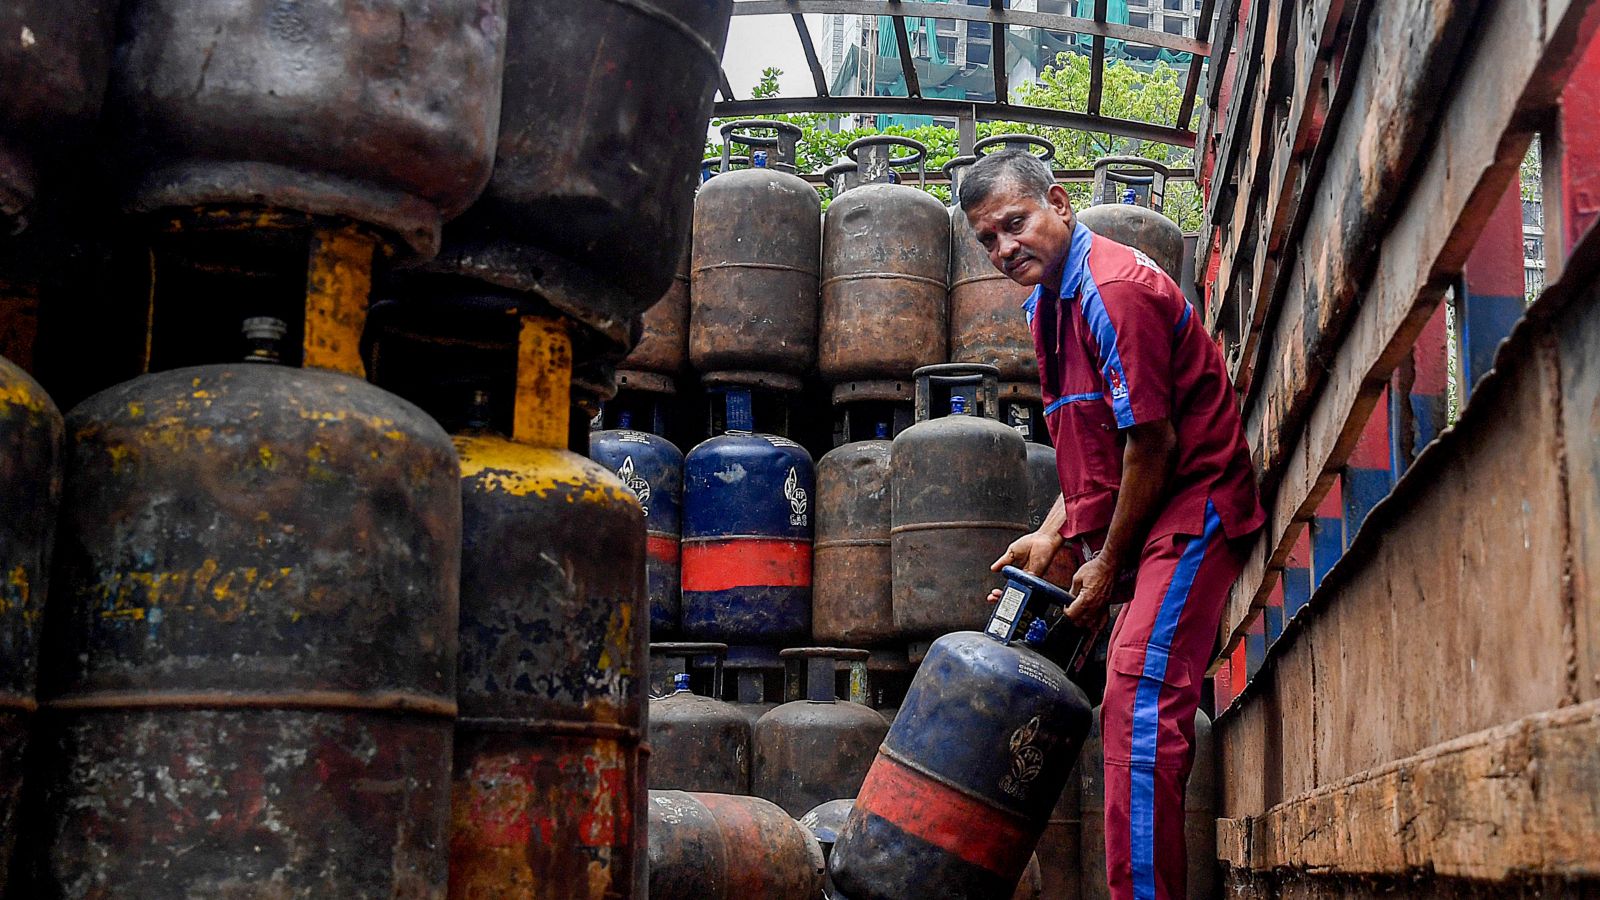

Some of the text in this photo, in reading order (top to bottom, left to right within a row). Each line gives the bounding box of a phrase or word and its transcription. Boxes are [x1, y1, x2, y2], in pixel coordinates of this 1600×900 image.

[795, 490, 806, 500] HP
[790, 513, 807, 527] GAS
[1018, 664, 1043, 678] CHECK
